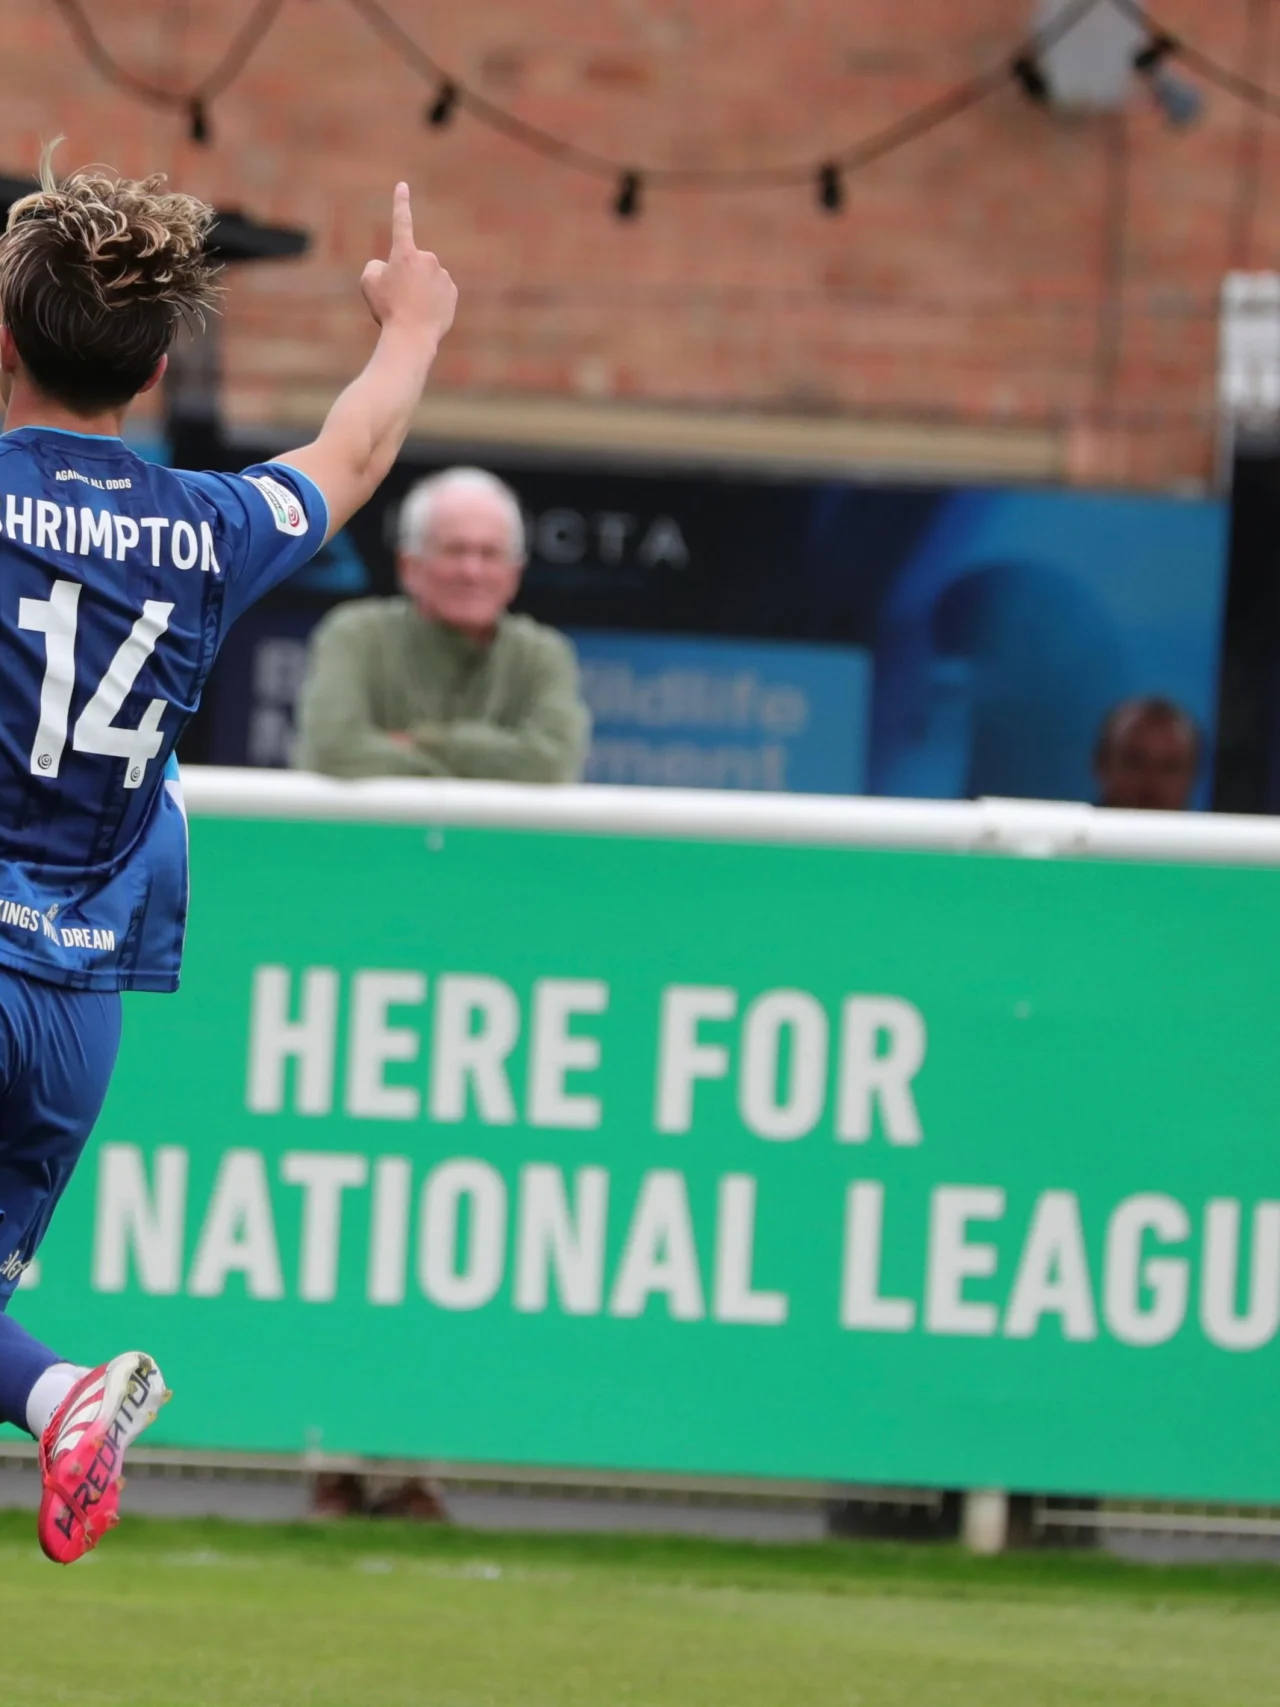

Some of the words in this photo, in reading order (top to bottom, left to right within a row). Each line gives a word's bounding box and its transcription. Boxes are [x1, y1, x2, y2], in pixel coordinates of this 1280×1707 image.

[106, 478, 132, 490] ODDS
[18, 580, 175, 788] 14
[60, 928, 115, 951] DREAM
[245, 963, 610, 1130] HERE
[653, 982, 926, 1148] FOR
[91, 1142, 790, 1327] NATIONAL
[839, 1179, 1280, 1354] LEAGU
